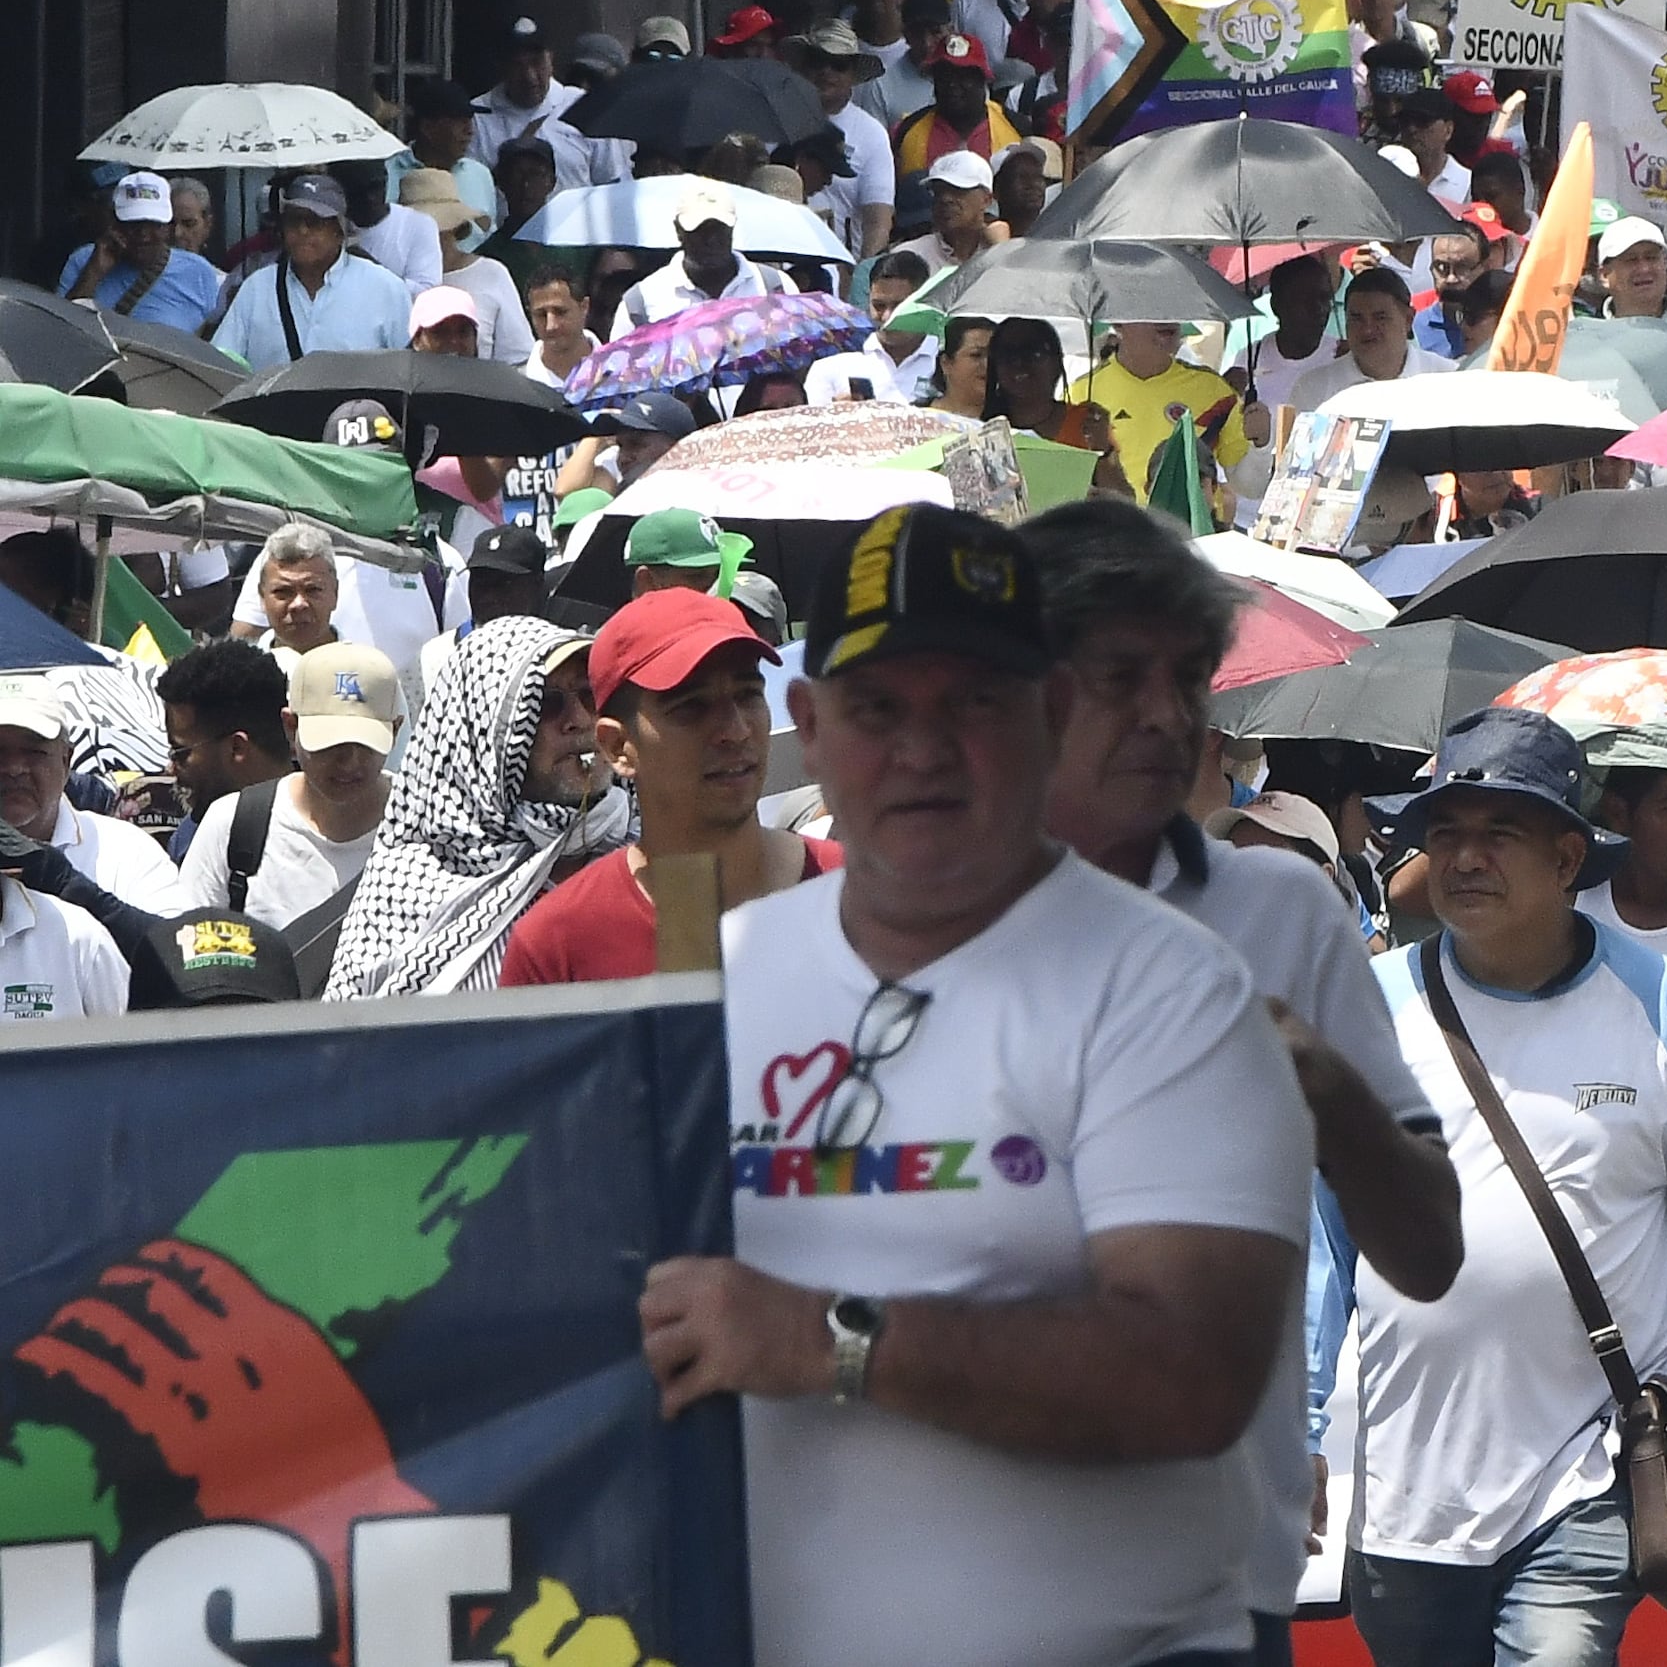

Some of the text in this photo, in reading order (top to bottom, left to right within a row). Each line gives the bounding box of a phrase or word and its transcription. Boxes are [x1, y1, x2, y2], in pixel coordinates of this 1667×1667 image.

[1221, 14, 1282, 45] CTC
[1168, 88, 1236, 102] SECCIONAL
[1274, 82, 1297, 95] DEL
[1298, 78, 1339, 91] CAUCA
[138, 814, 163, 825] SAN
[5, 993, 54, 1005] SUTEV
